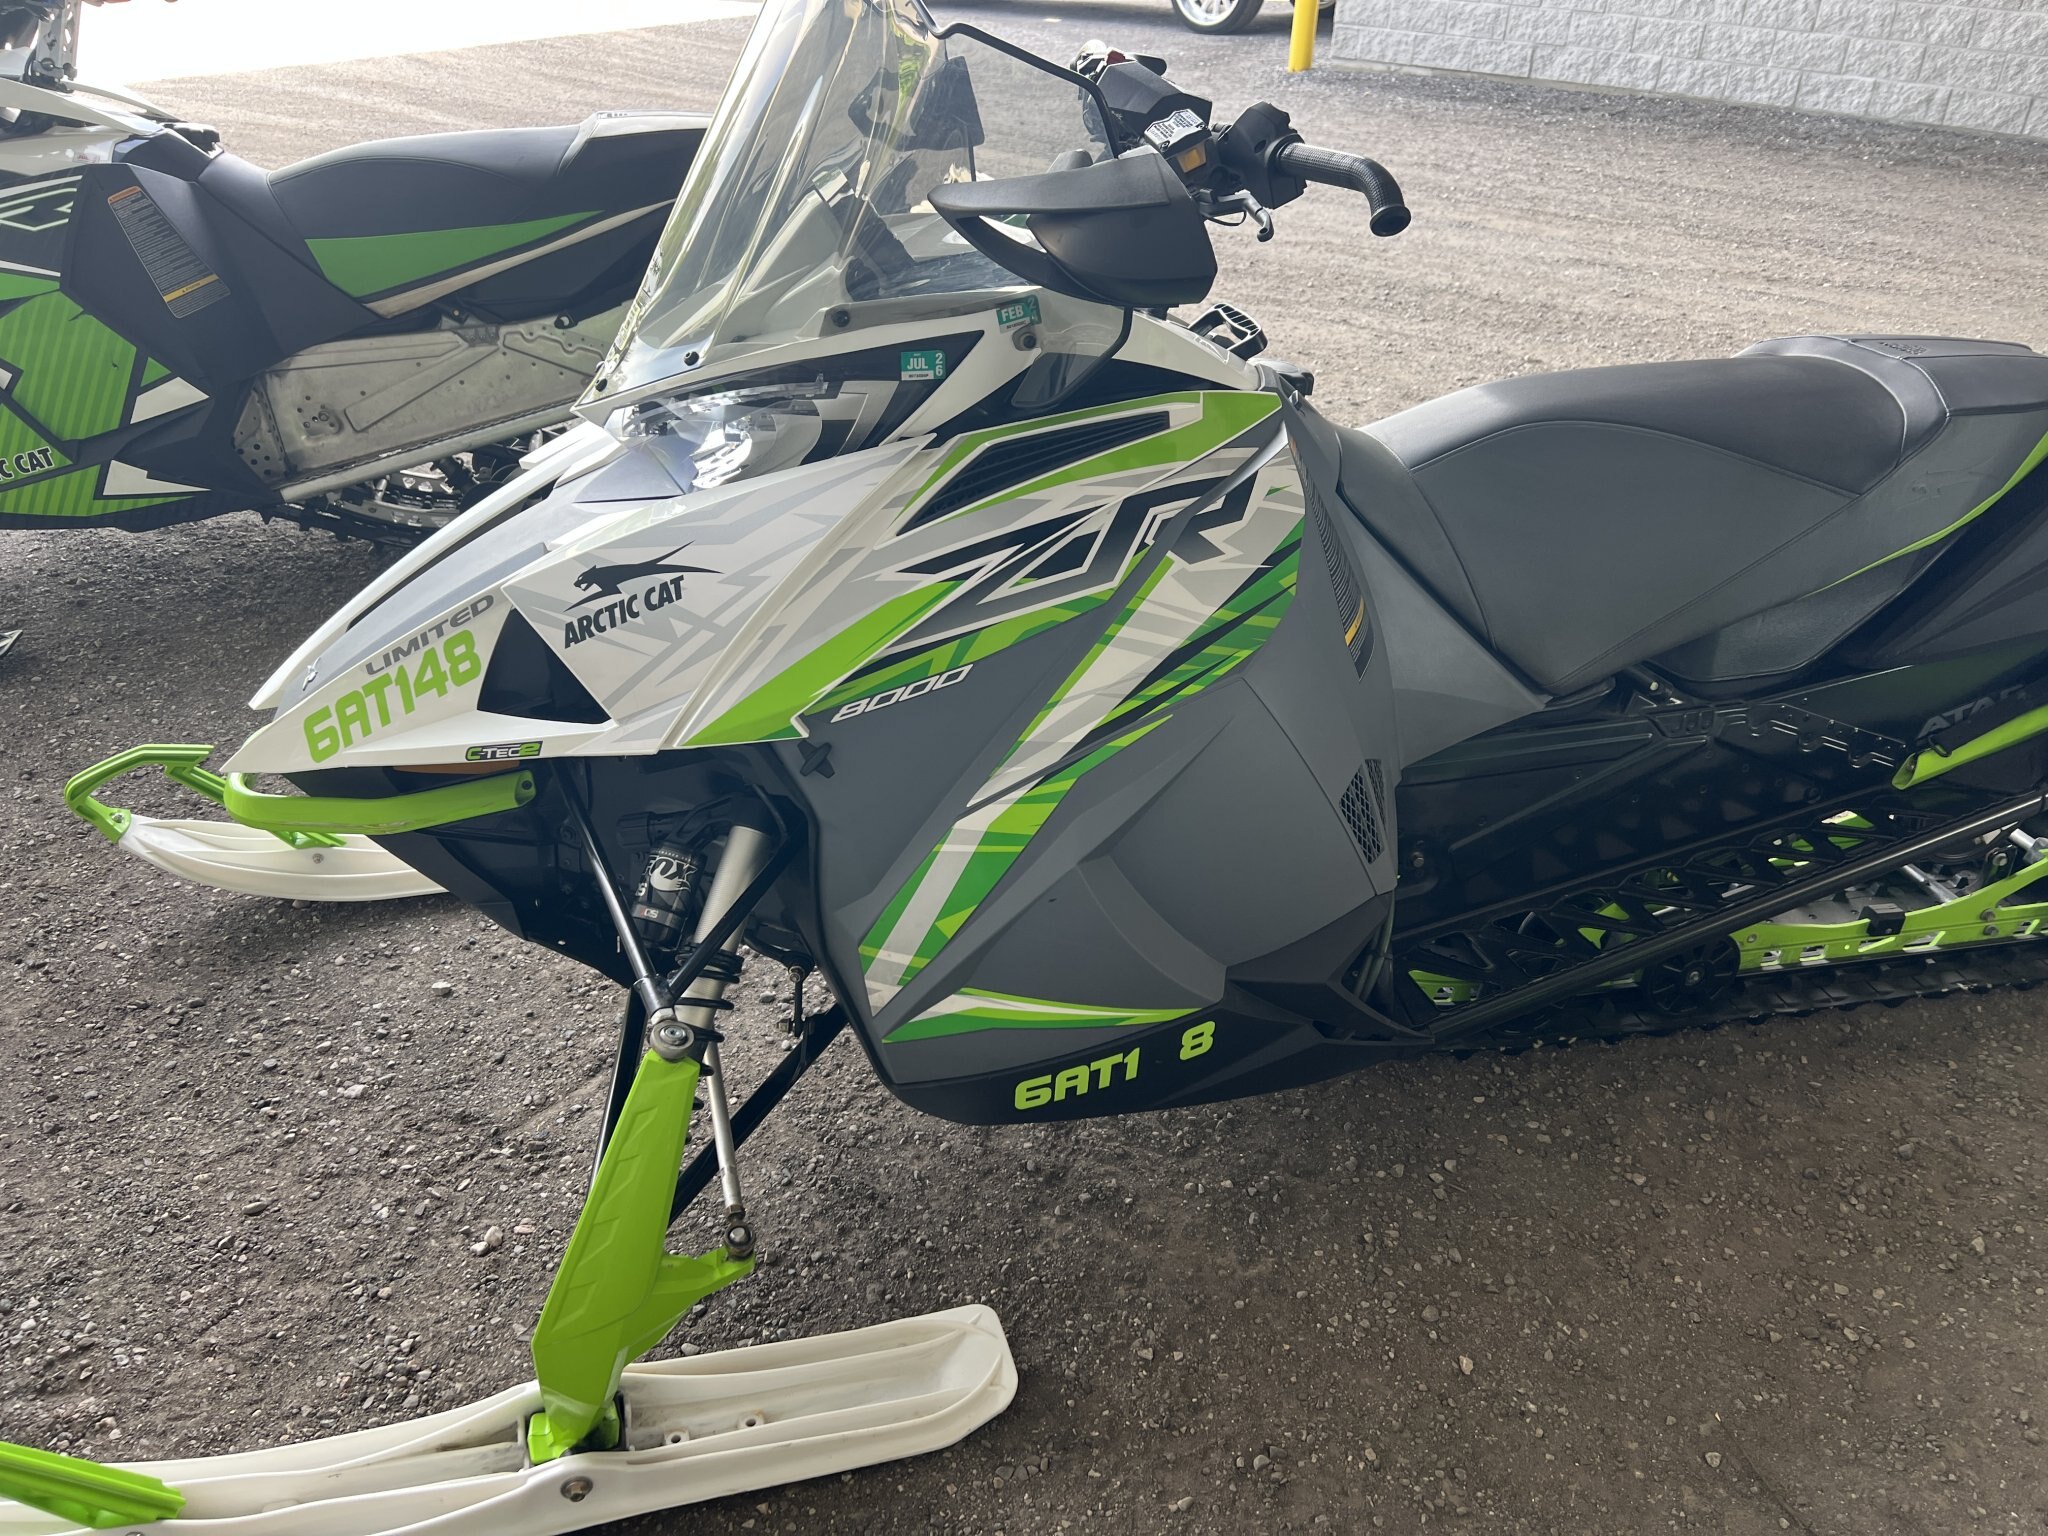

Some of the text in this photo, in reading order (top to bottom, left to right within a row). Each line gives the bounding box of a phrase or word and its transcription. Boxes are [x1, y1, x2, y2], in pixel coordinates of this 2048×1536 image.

[1001, 305, 1024, 321] FEB
[907, 358, 929, 369] JUL
[13, 446, 55, 475] CAT
[365, 594, 495, 676] LIMITED
[564, 574, 685, 649] ARCTIC CAT
[303, 629, 482, 763] 6AT148
[830, 663, 974, 723] 8000
[1014, 1020, 1216, 1110] 6AT1 8
